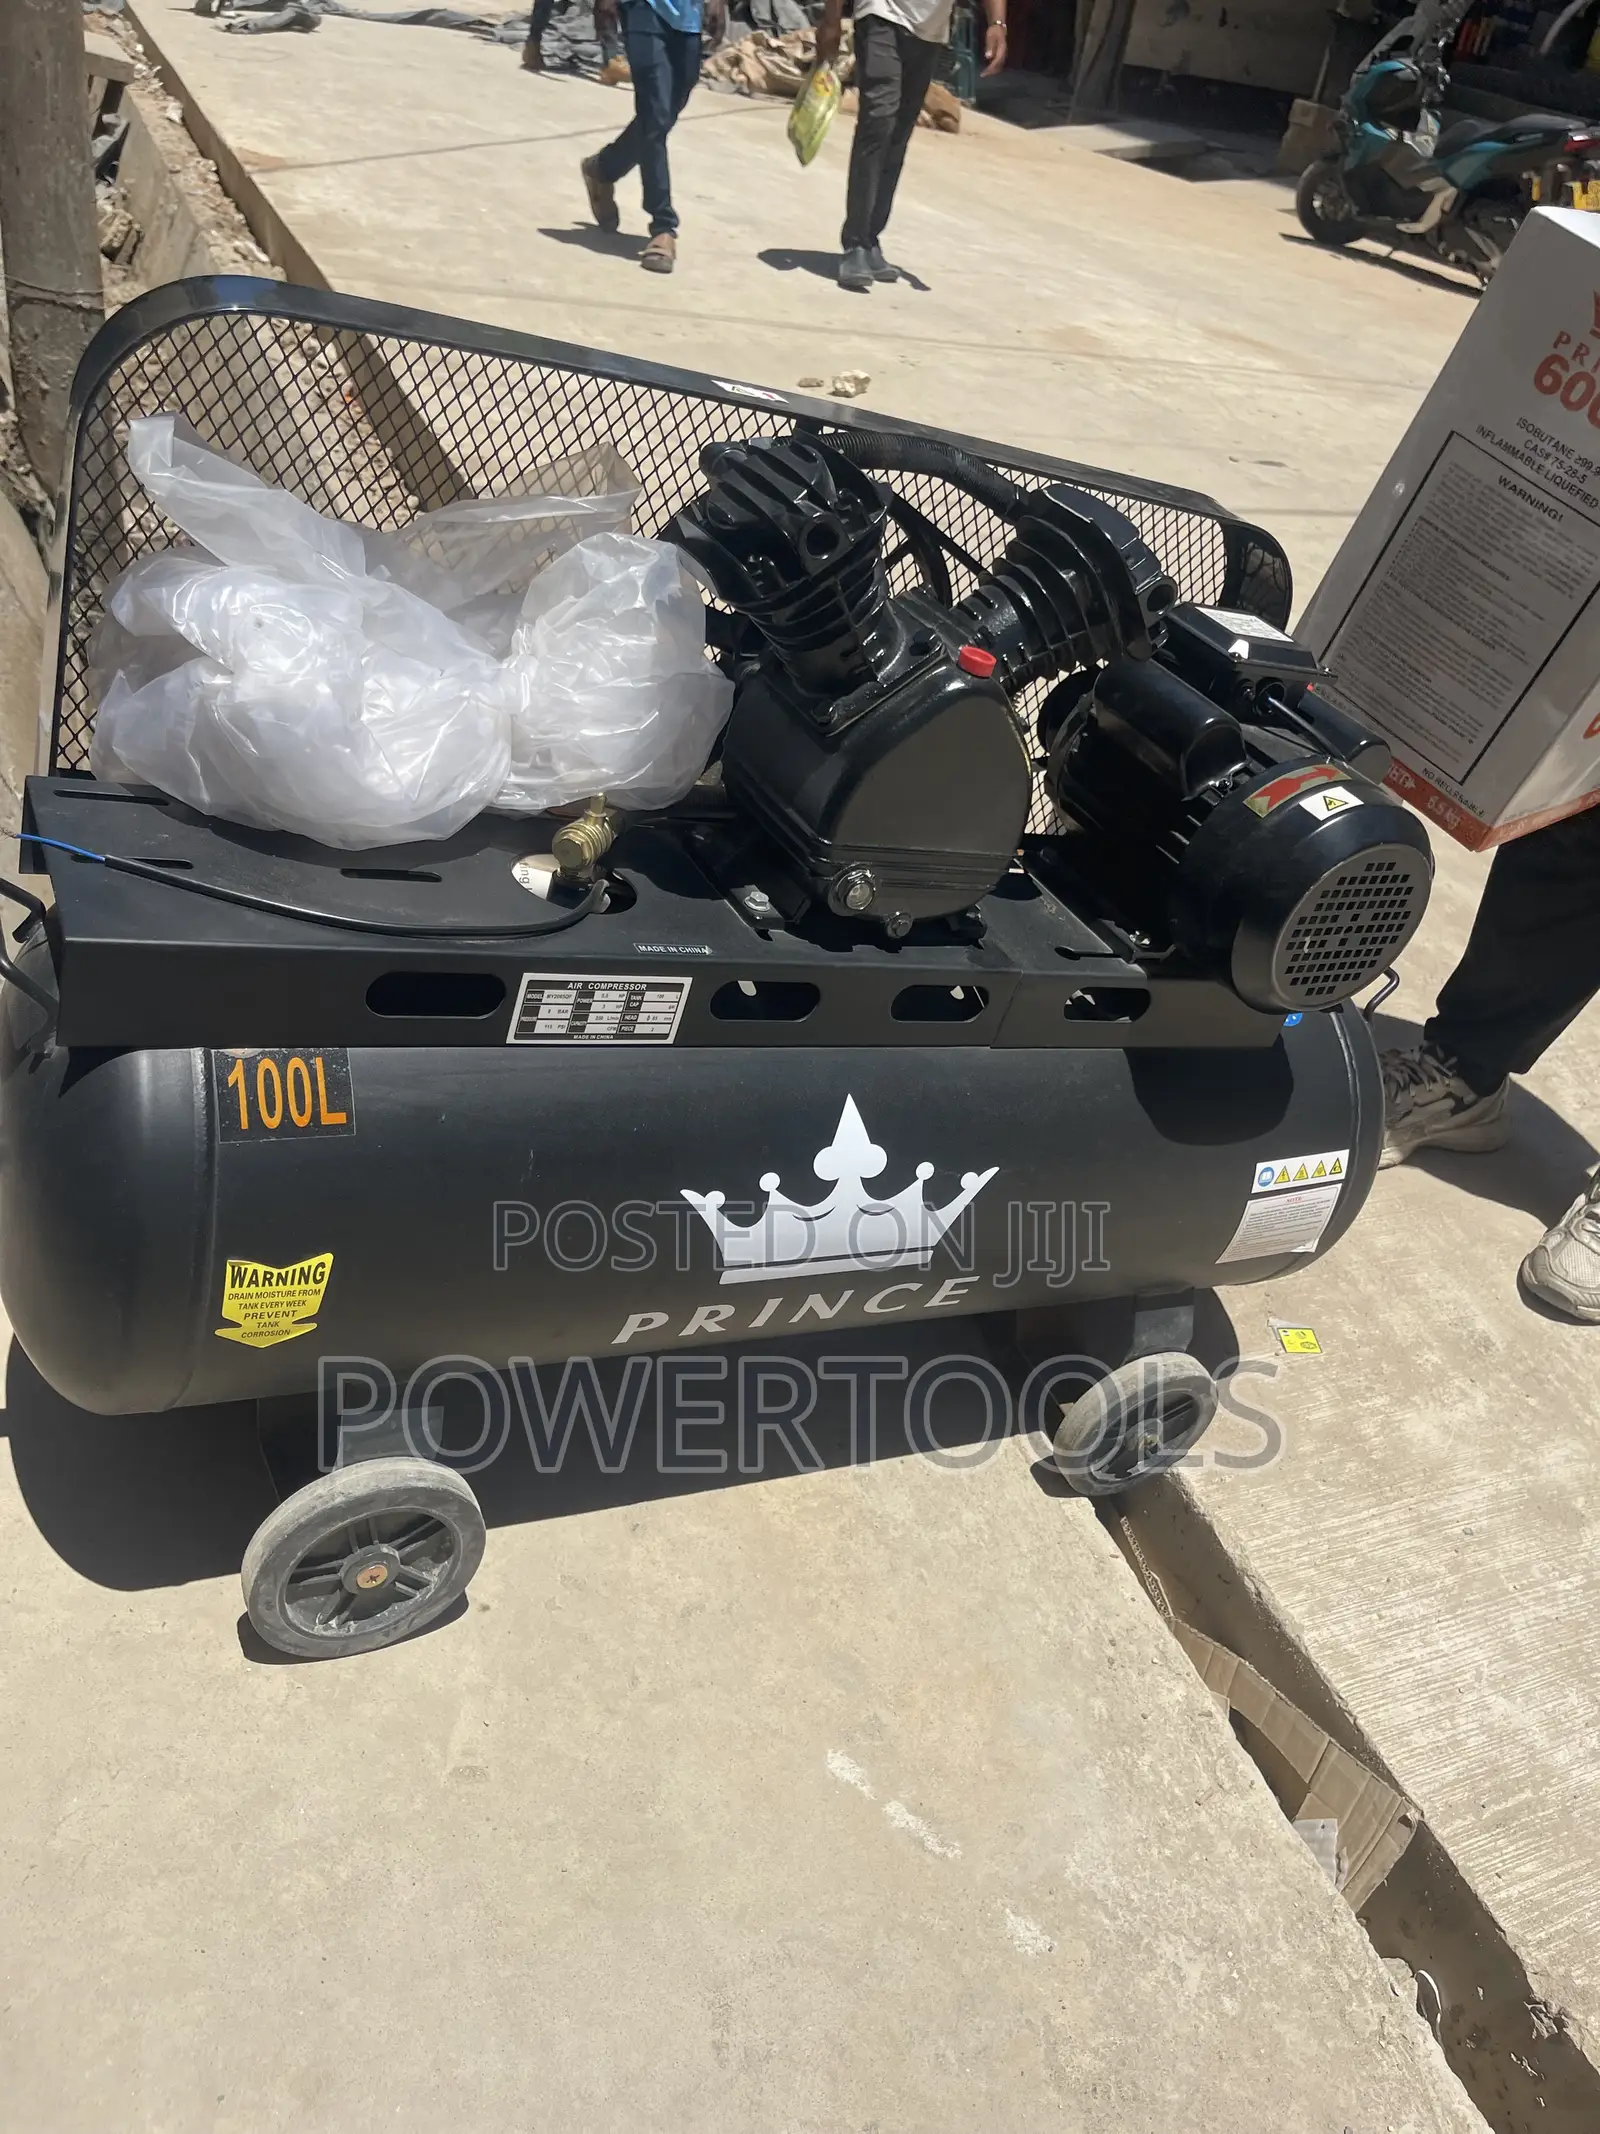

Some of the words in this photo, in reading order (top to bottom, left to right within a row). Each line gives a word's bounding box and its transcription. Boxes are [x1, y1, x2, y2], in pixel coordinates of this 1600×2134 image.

[1516, 417, 1576, 460] ISOBUTANE
[1475, 424, 1545, 475] INFLAMMABLE
[1543, 470, 1599, 509] LIQUEFIED
[1498, 475, 1564, 522] WARNING!
[638, 945, 667, 953] MADE
[679, 946, 708, 954] CHINA
[567, 982, 583, 990] AIR
[588, 982, 648, 991] COMPRESSOR
[227, 1056, 347, 1130] 100L
[230, 1262, 326, 1289] WARNING
[228, 1292, 254, 1301] DRAIN
[255, 1290, 297, 1299] MOISTURE
[298, 1288, 321, 1297] FROM
[260, 1301, 285, 1309] EVERY
[610, 1275, 981, 1345] PRINCE
[243, 1310, 298, 1320] PREVENT
[256, 1321, 280, 1329] TANK
[241, 1329, 292, 1339] CORROSION
